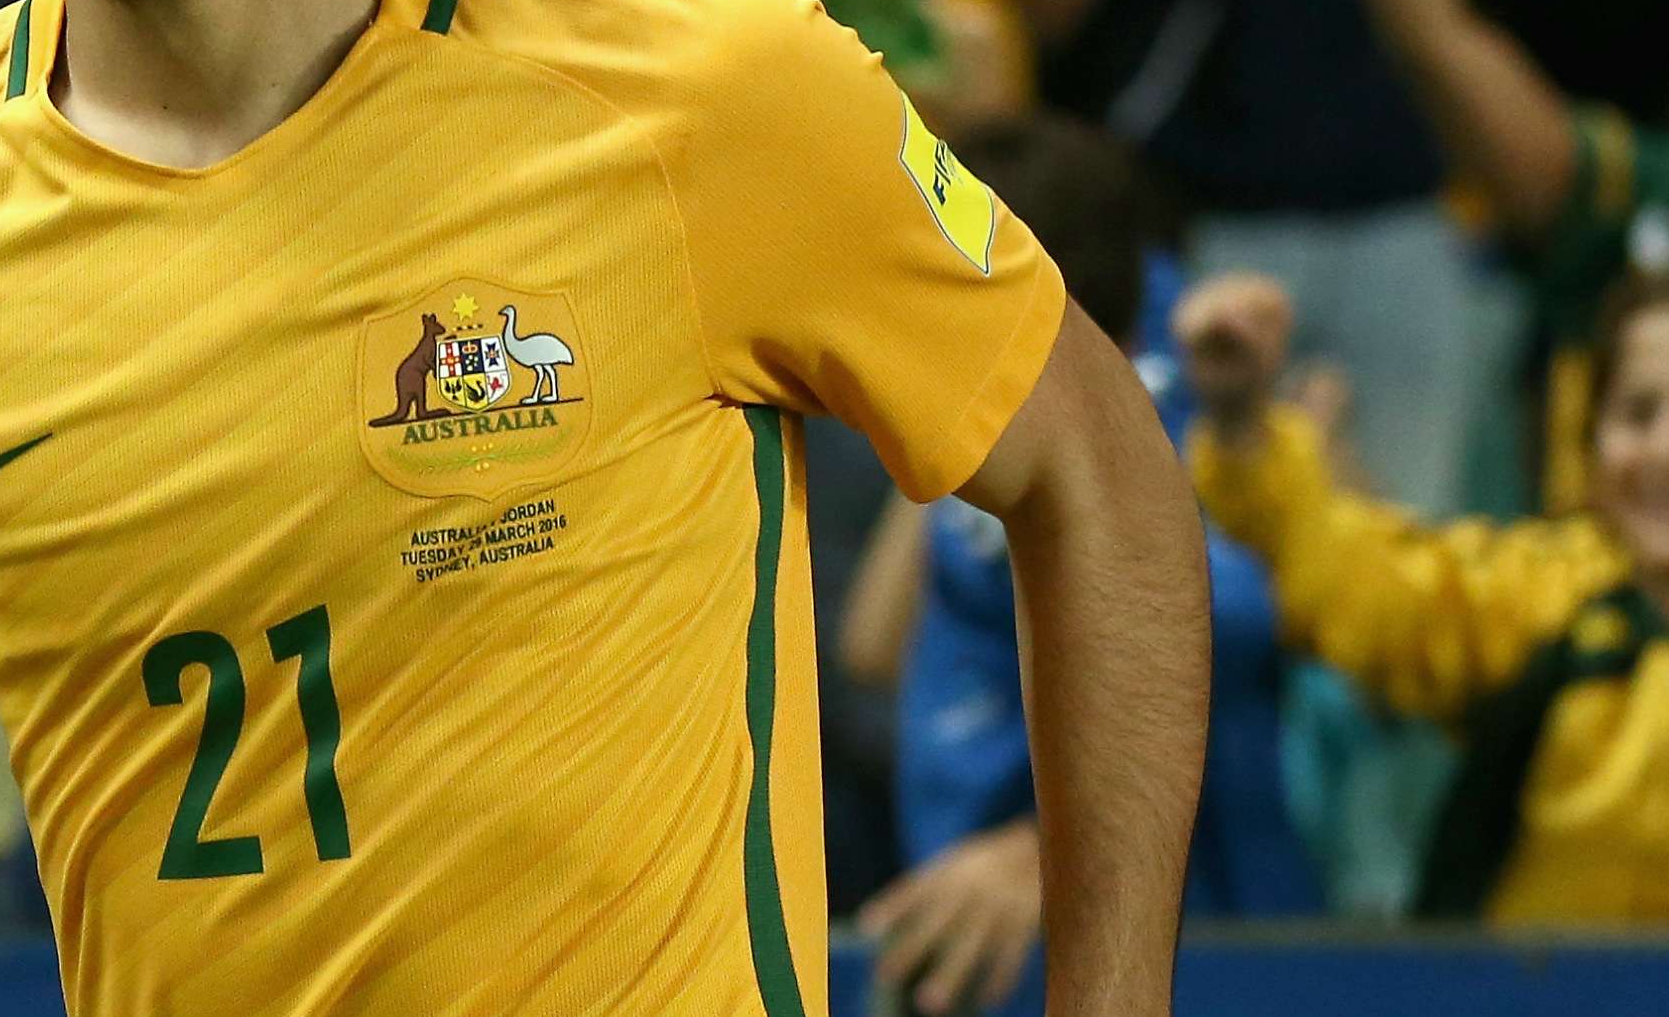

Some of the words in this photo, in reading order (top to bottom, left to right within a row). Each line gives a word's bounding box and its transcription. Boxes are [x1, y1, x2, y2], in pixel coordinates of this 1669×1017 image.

[402, 407, 558, 445] AUSTRALIA
[500, 498, 555, 523] JORDAN
[401, 544, 464, 567] TUESDAY
[485, 522, 535, 544] MARCH
[539, 514, 567, 534] 2016
[479, 536, 554, 565] AUSTRALIA
[142, 603, 352, 880] 21
